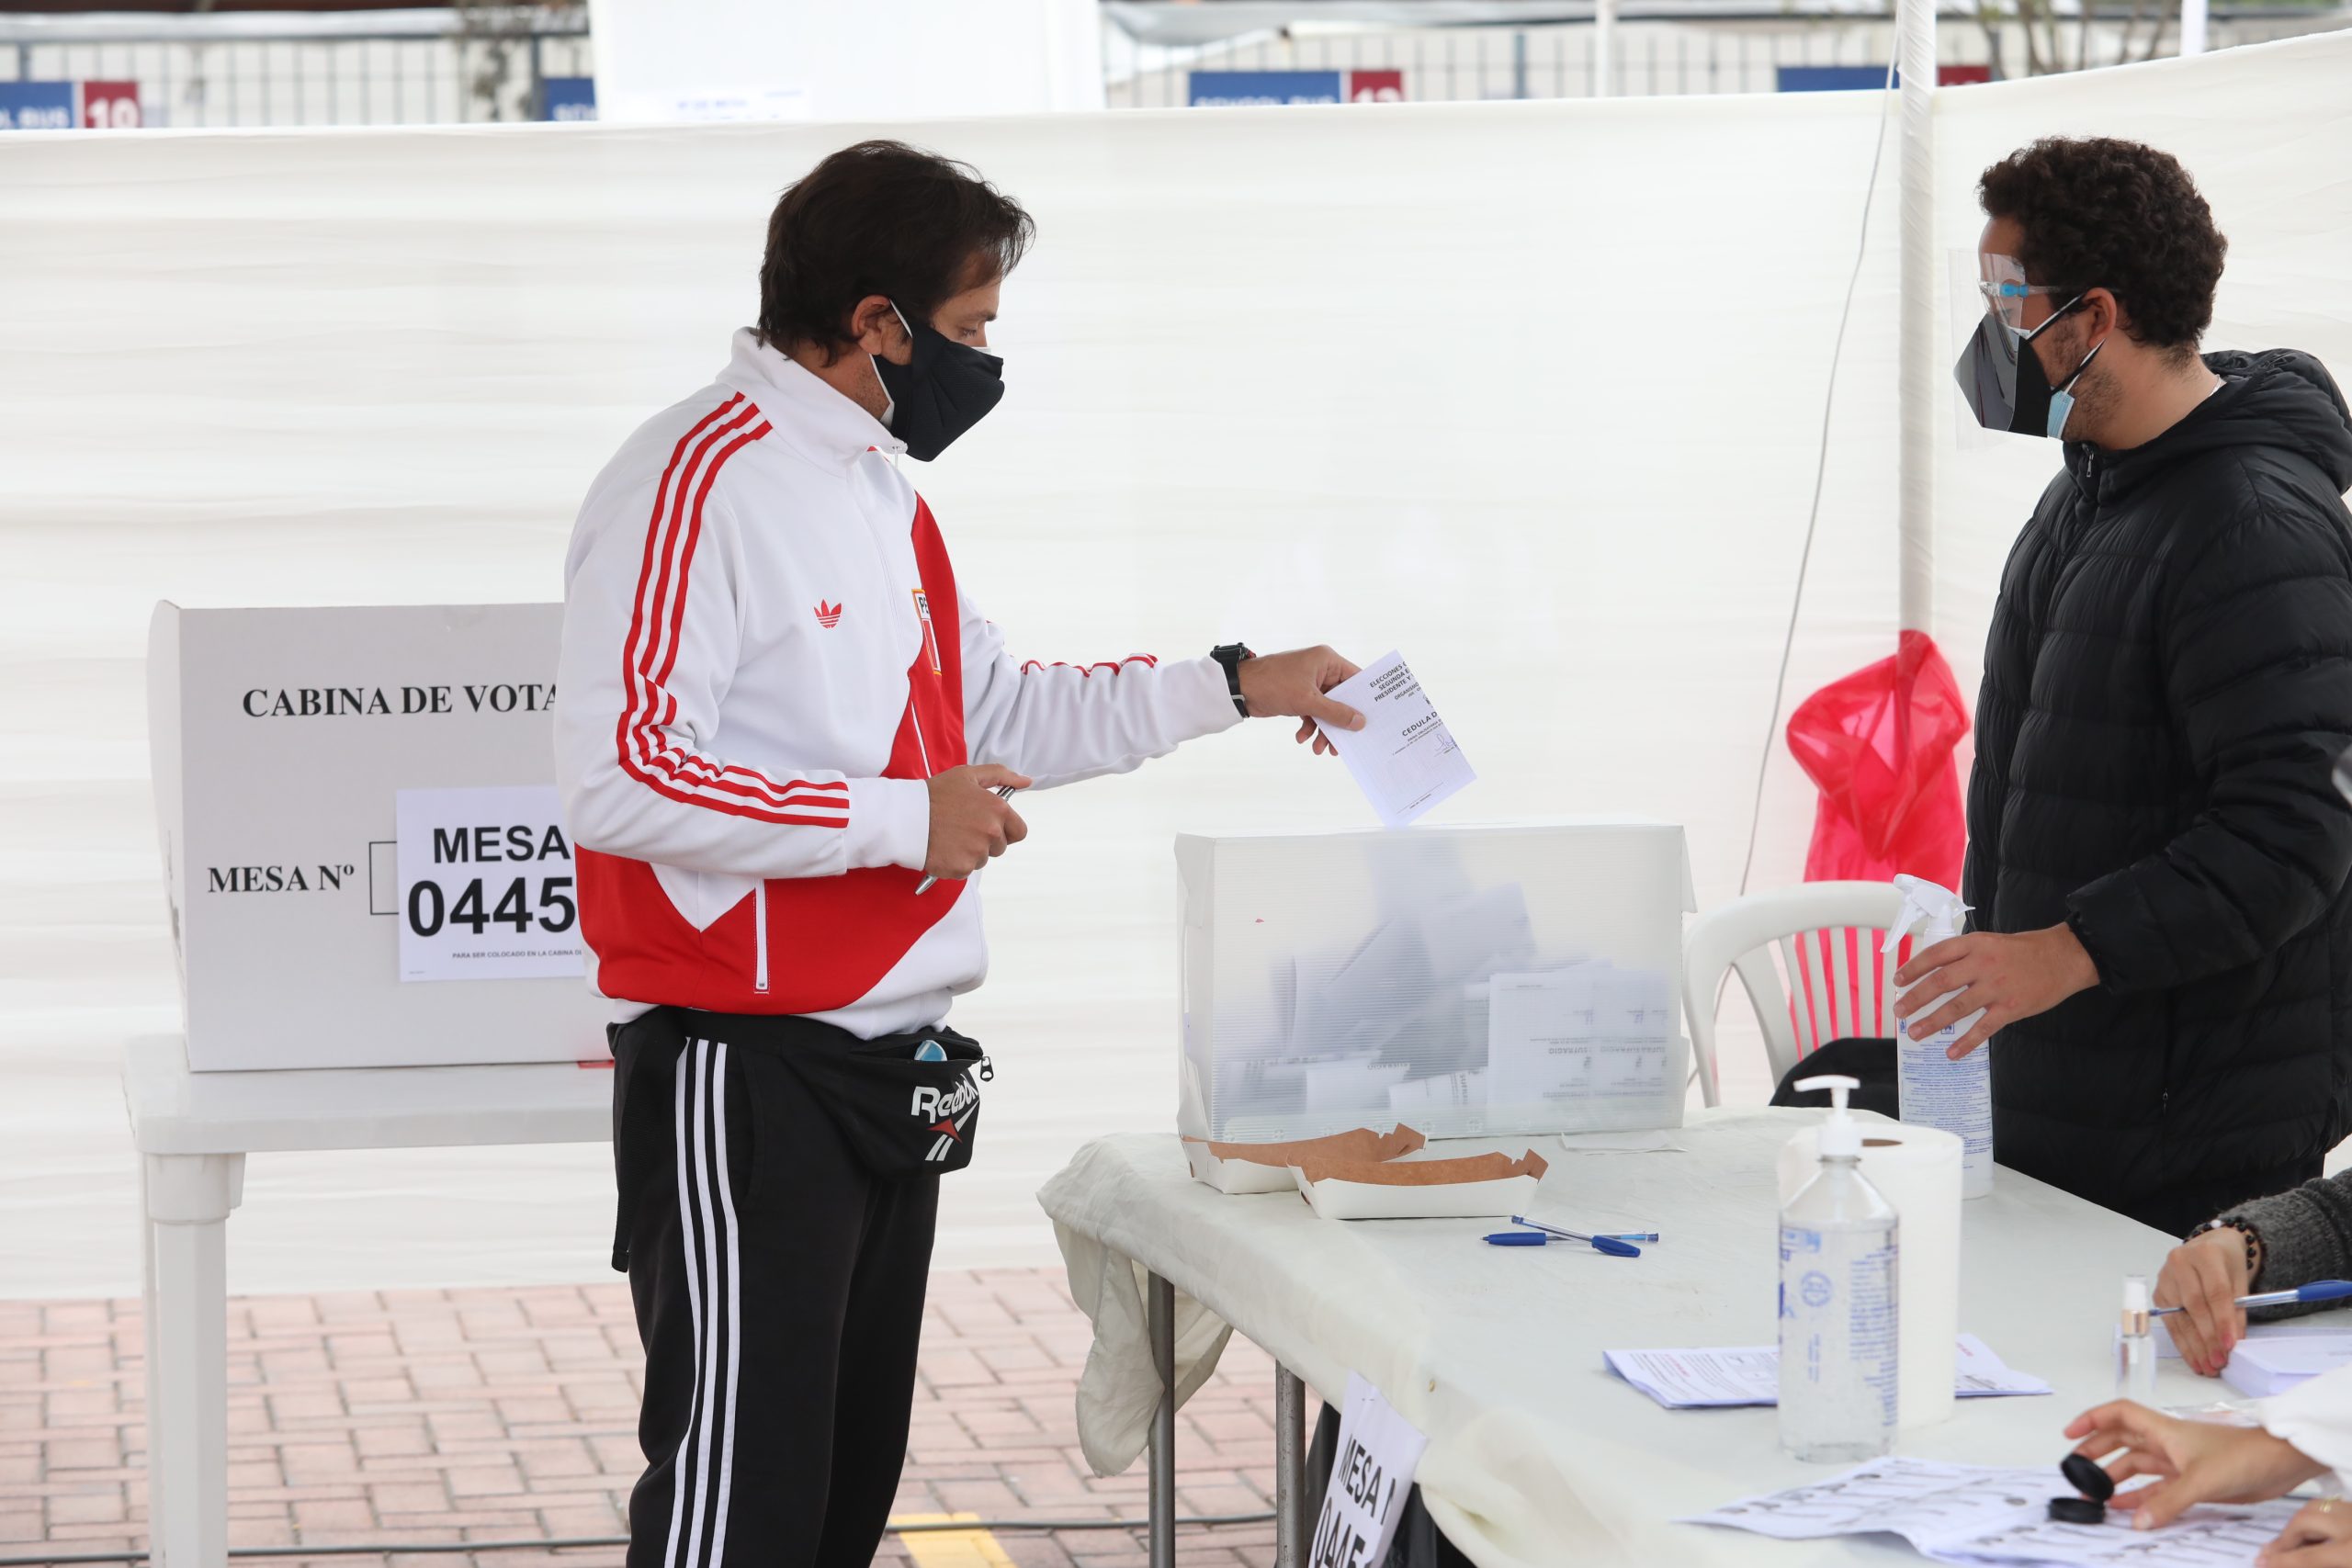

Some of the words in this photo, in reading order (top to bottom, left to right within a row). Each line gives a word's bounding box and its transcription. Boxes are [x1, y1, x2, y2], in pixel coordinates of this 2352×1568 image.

[85, 97, 140, 129] 10
[1369, 663, 1403, 688] ELECCIONES
[1374, 679, 1408, 703] PRESIDENTE
[1378, 671, 1405, 691] SEGUNDA
[243, 687, 390, 717] CABINA
[401, 686, 452, 715] DE
[1401, 716, 1431, 737] CEDULA
[433, 824, 570, 864] MESA
[208, 866, 307, 893] MESA
[408, 875, 576, 938] 0445
[910, 1073, 979, 1124] Reebok
[1338, 1433, 1382, 1519] MESA
